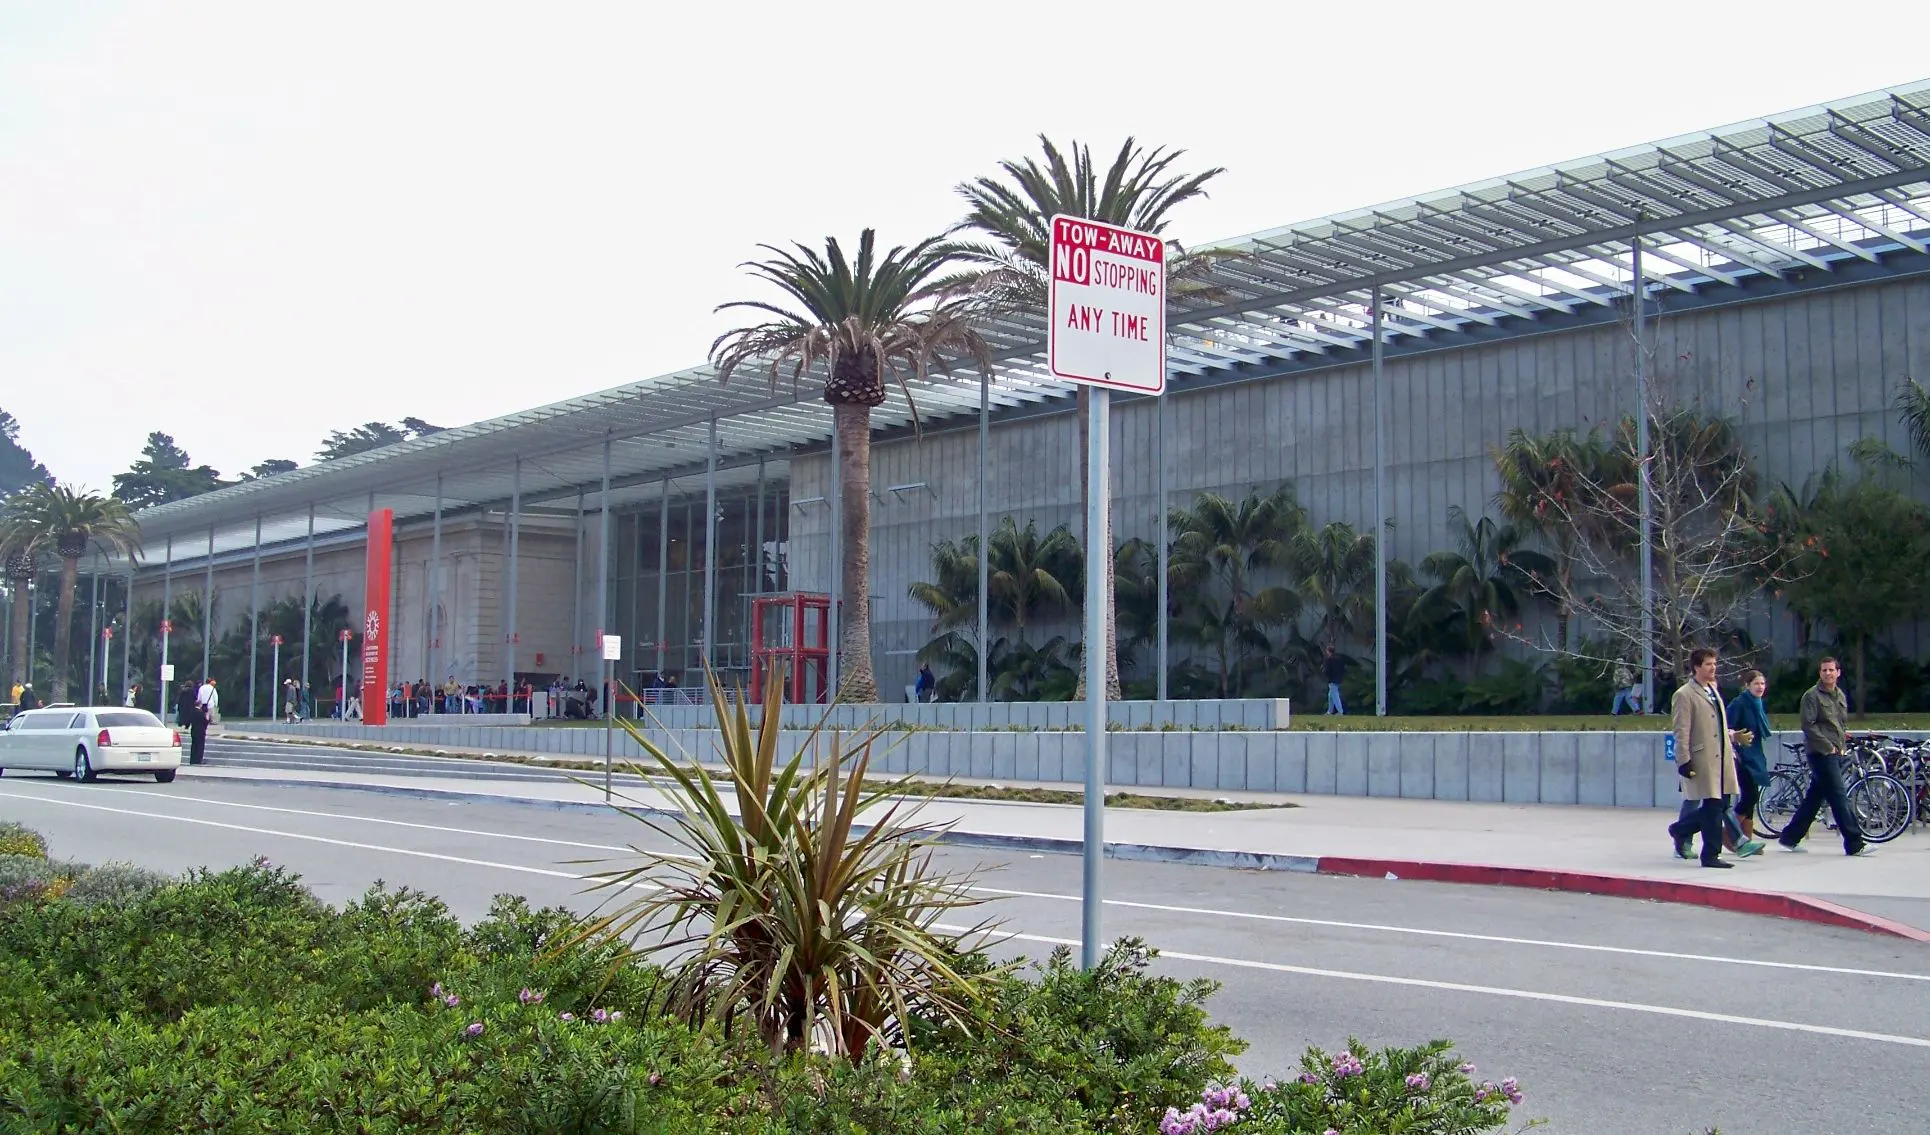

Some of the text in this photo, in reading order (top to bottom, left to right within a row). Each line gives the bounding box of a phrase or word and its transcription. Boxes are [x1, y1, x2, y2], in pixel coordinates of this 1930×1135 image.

[1060, 222, 1157, 260] TOW-AWAY
[1056, 243, 1156, 296] NO STOPPING
[1067, 303, 1148, 342] ANY TIME
